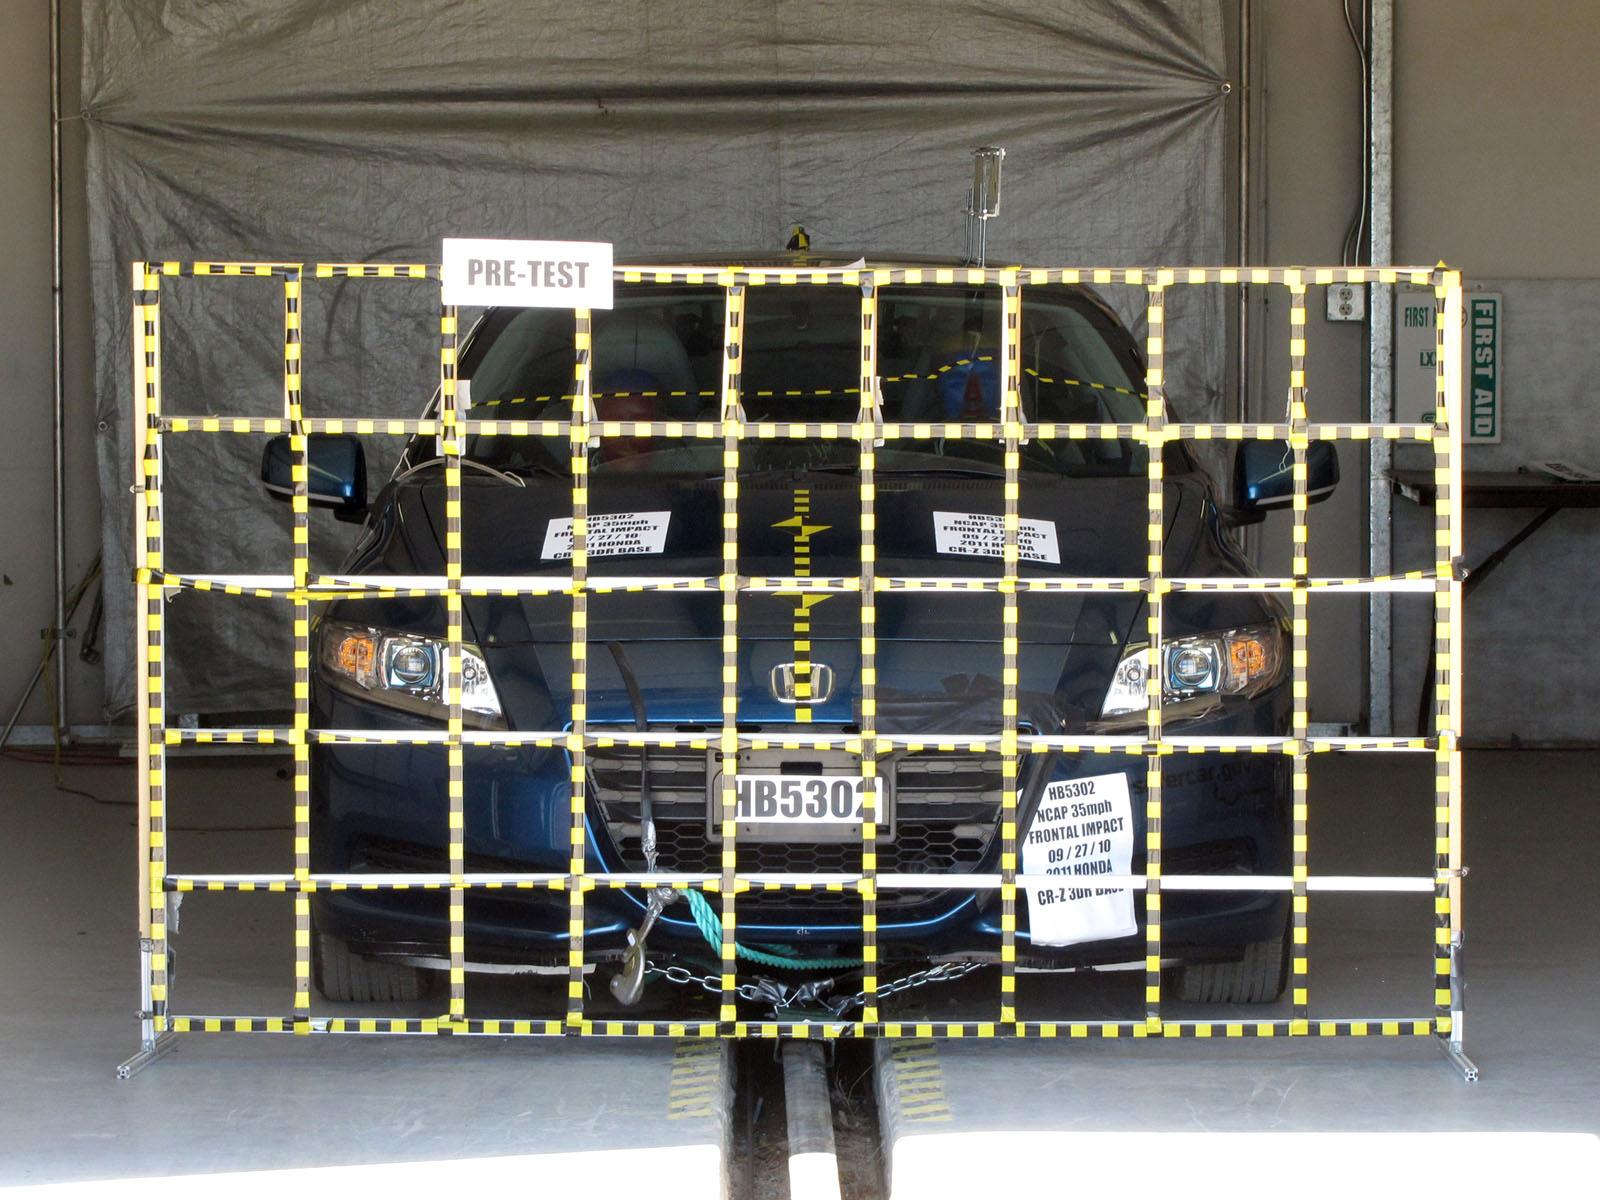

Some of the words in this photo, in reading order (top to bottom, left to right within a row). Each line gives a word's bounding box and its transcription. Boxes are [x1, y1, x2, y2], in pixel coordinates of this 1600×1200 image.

[468, 258, 590, 289] PRE-TEST
[1404, 306, 1429, 328] FIRST
[1474, 302, 1494, 379] FIRST
[1474, 387, 1494, 435] AID
[566, 521, 600, 530] NAP
[953, 519, 987, 527] NCAP
[989, 522, 1035, 532] 35ph
[968, 514, 1006, 522] HB53
[554, 527, 607, 537] FRTAL
[610, 525, 659, 533] IMPACT
[943, 525, 996, 534] FRONTAL
[998, 530, 1047, 540] IPACT
[598, 540, 641, 548] HONDA
[948, 546, 979, 554] CR-Z
[960, 539, 988, 547] 2011
[991, 542, 1035, 552] HDA
[1048, 780, 1096, 801] HB5302
[1037, 805, 1069, 823] NCAP
[1070, 799, 1113, 818] 35mph
[1028, 824, 1080, 845] FRONTAL
[1081, 817, 1125, 837] IMPACT
[1048, 848, 1064, 863] 09
[1074, 843, 1088, 858] 27
[1098, 838, 1111, 854] 10
[1073, 859, 1113, 876] HONDA
[1037, 888, 1067, 906] CR-Z
[1094, 887, 1125, 897] BA
